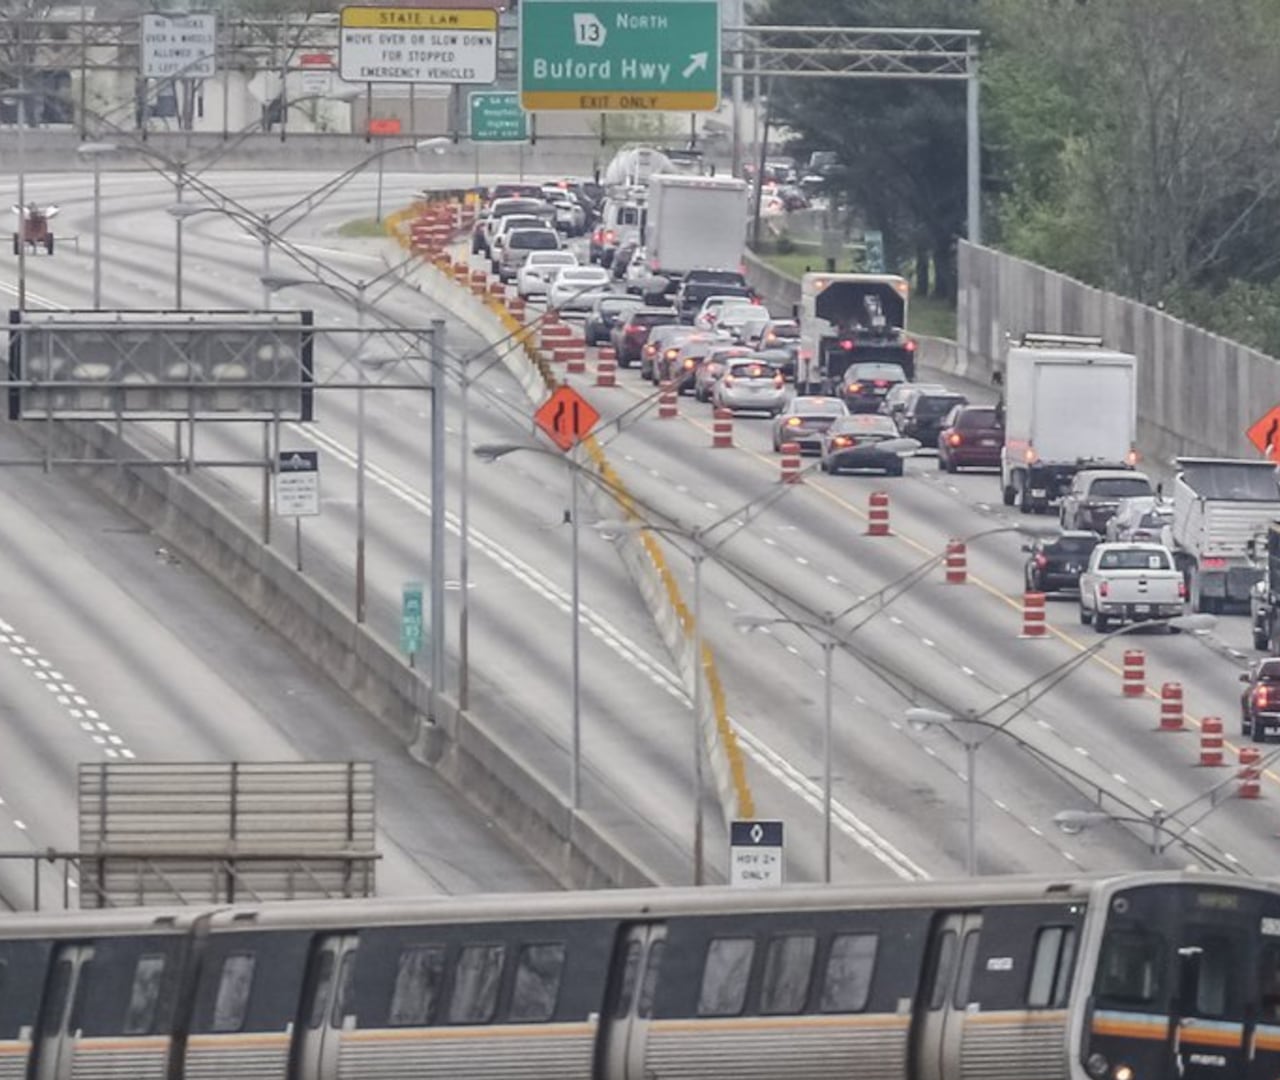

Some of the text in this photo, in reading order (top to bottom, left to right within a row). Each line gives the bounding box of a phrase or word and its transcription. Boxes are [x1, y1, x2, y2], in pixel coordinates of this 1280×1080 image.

[379, 12, 459, 25] STATE LAW
[616, 13, 669, 29] NORTH
[579, 23, 601, 42] 13
[345, 34, 493, 46] MOVE OVER OR SLOW DOWN
[381, 50, 456, 62] FOR STOPPED
[360, 66, 476, 79] EMERGENCY VEHICLES
[533, 57, 671, 84] Buford Hwy
[579, 95, 658, 109] EXIT ONLY
[736, 854, 760, 864] HOV
[741, 870, 770, 880] ONLY
